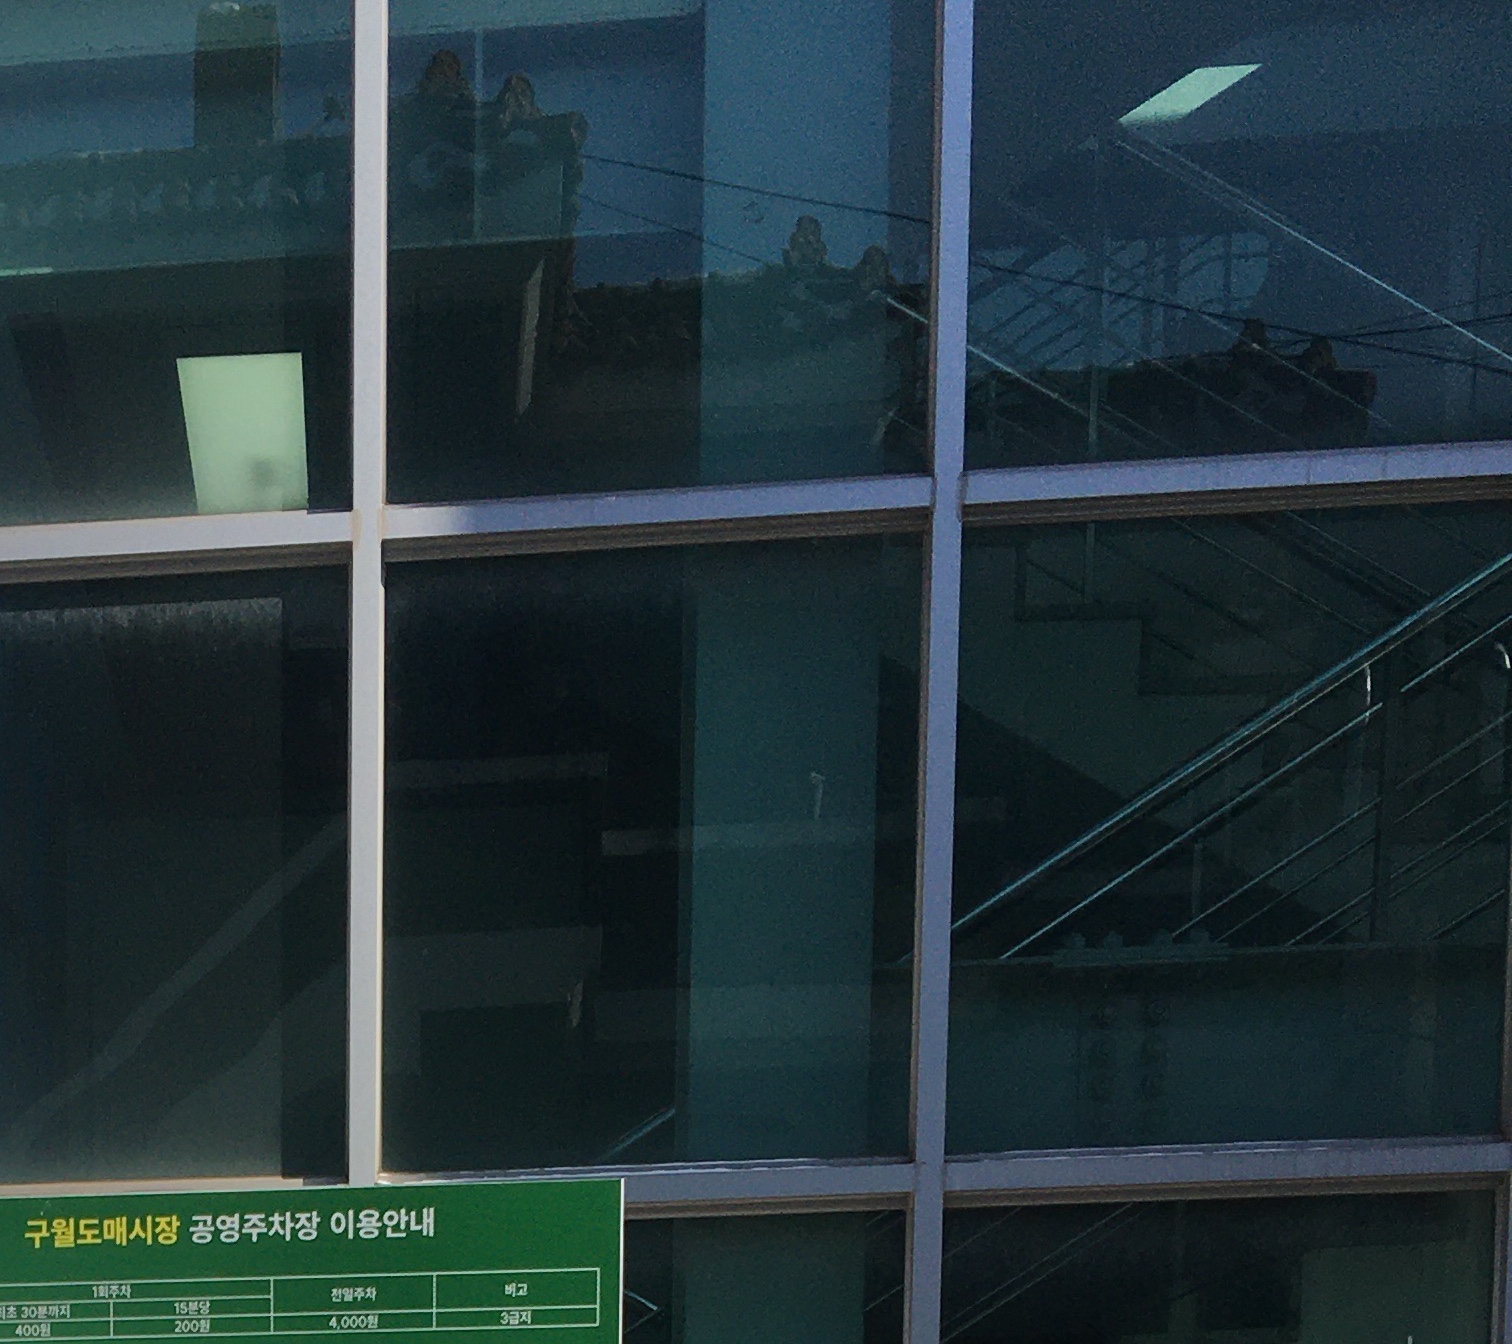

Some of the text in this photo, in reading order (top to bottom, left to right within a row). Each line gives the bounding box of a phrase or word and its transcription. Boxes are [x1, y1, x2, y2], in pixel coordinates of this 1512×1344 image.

[24, 1206, 436, 1249] 구월도매시장 공영주차장 이용안내
[92, 1284, 131, 1299] 1회주차
[504, 1282, 528, 1297] 비고
[21, 1303, 71, 1319] 30분까지
[174, 1301, 210, 1314] 15분당
[329, 1314, 379, 1330] 4,000원
[500, 1310, 532, 1325] 3급지
[15, 1323, 51, 1337] 400원
[174, 1319, 210, 1333] 200원
